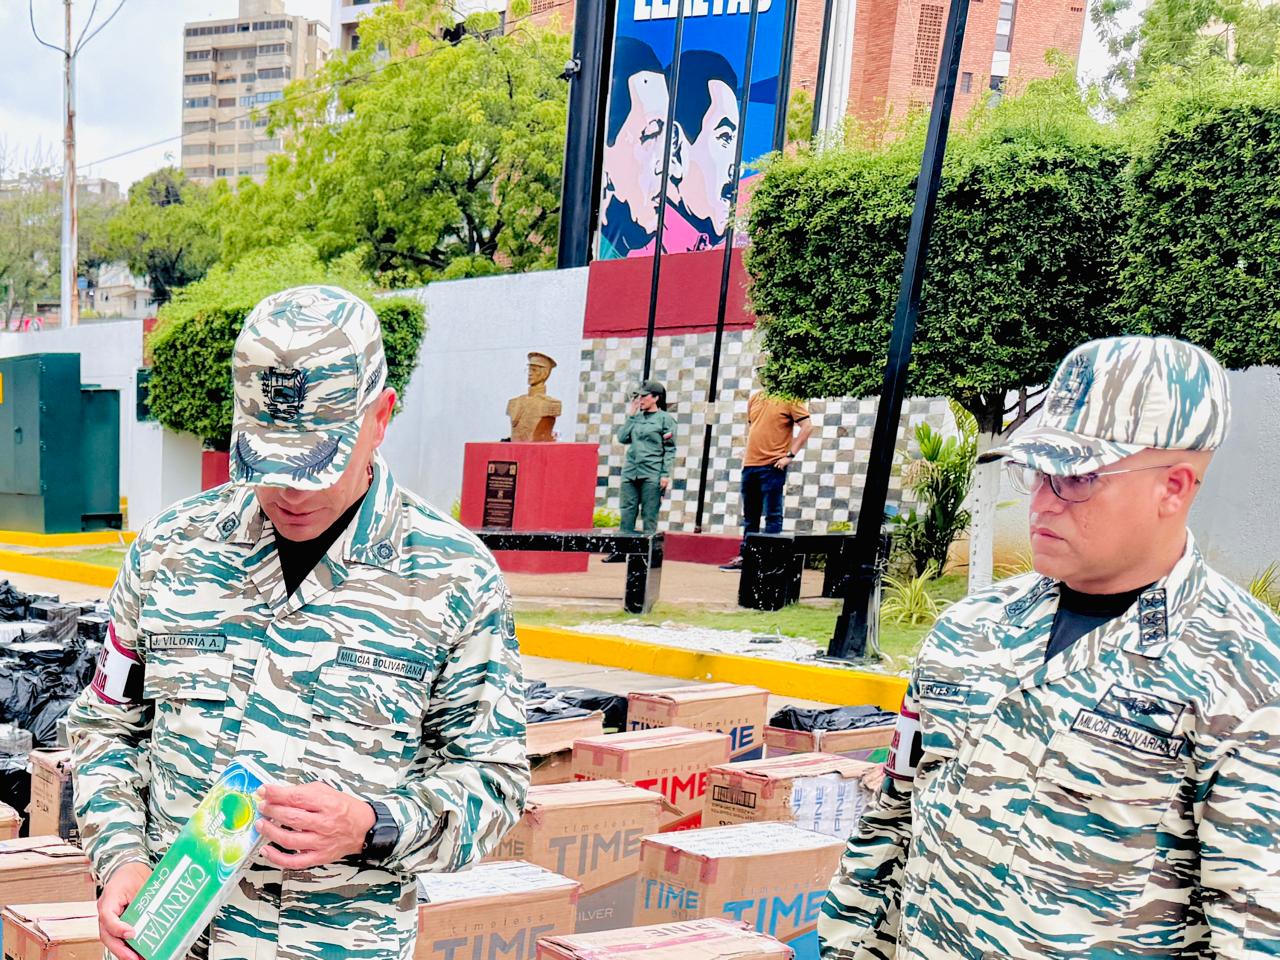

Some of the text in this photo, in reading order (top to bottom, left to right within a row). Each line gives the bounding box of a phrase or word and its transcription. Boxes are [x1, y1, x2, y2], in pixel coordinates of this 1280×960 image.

[163, 636, 206, 647] VILORIA
[209, 639, 220, 648] A.
[340, 651, 423, 677] MILICIA BOLIVARIANA
[1077, 714, 1179, 752] MILICIA BOLIVARIANA
[834, 784, 846, 832] PINE
[564, 819, 636, 833] timeless
[492, 840, 525, 858] IME
[549, 827, 644, 877] TIME
[133, 867, 170, 915] CHANGE
[644, 879, 700, 911] TIME
[136, 864, 208, 951] CARNIVAL
[577, 907, 614, 921] ILVER
[722, 889, 829, 936] TIME
[643, 921, 709, 938] PINE
